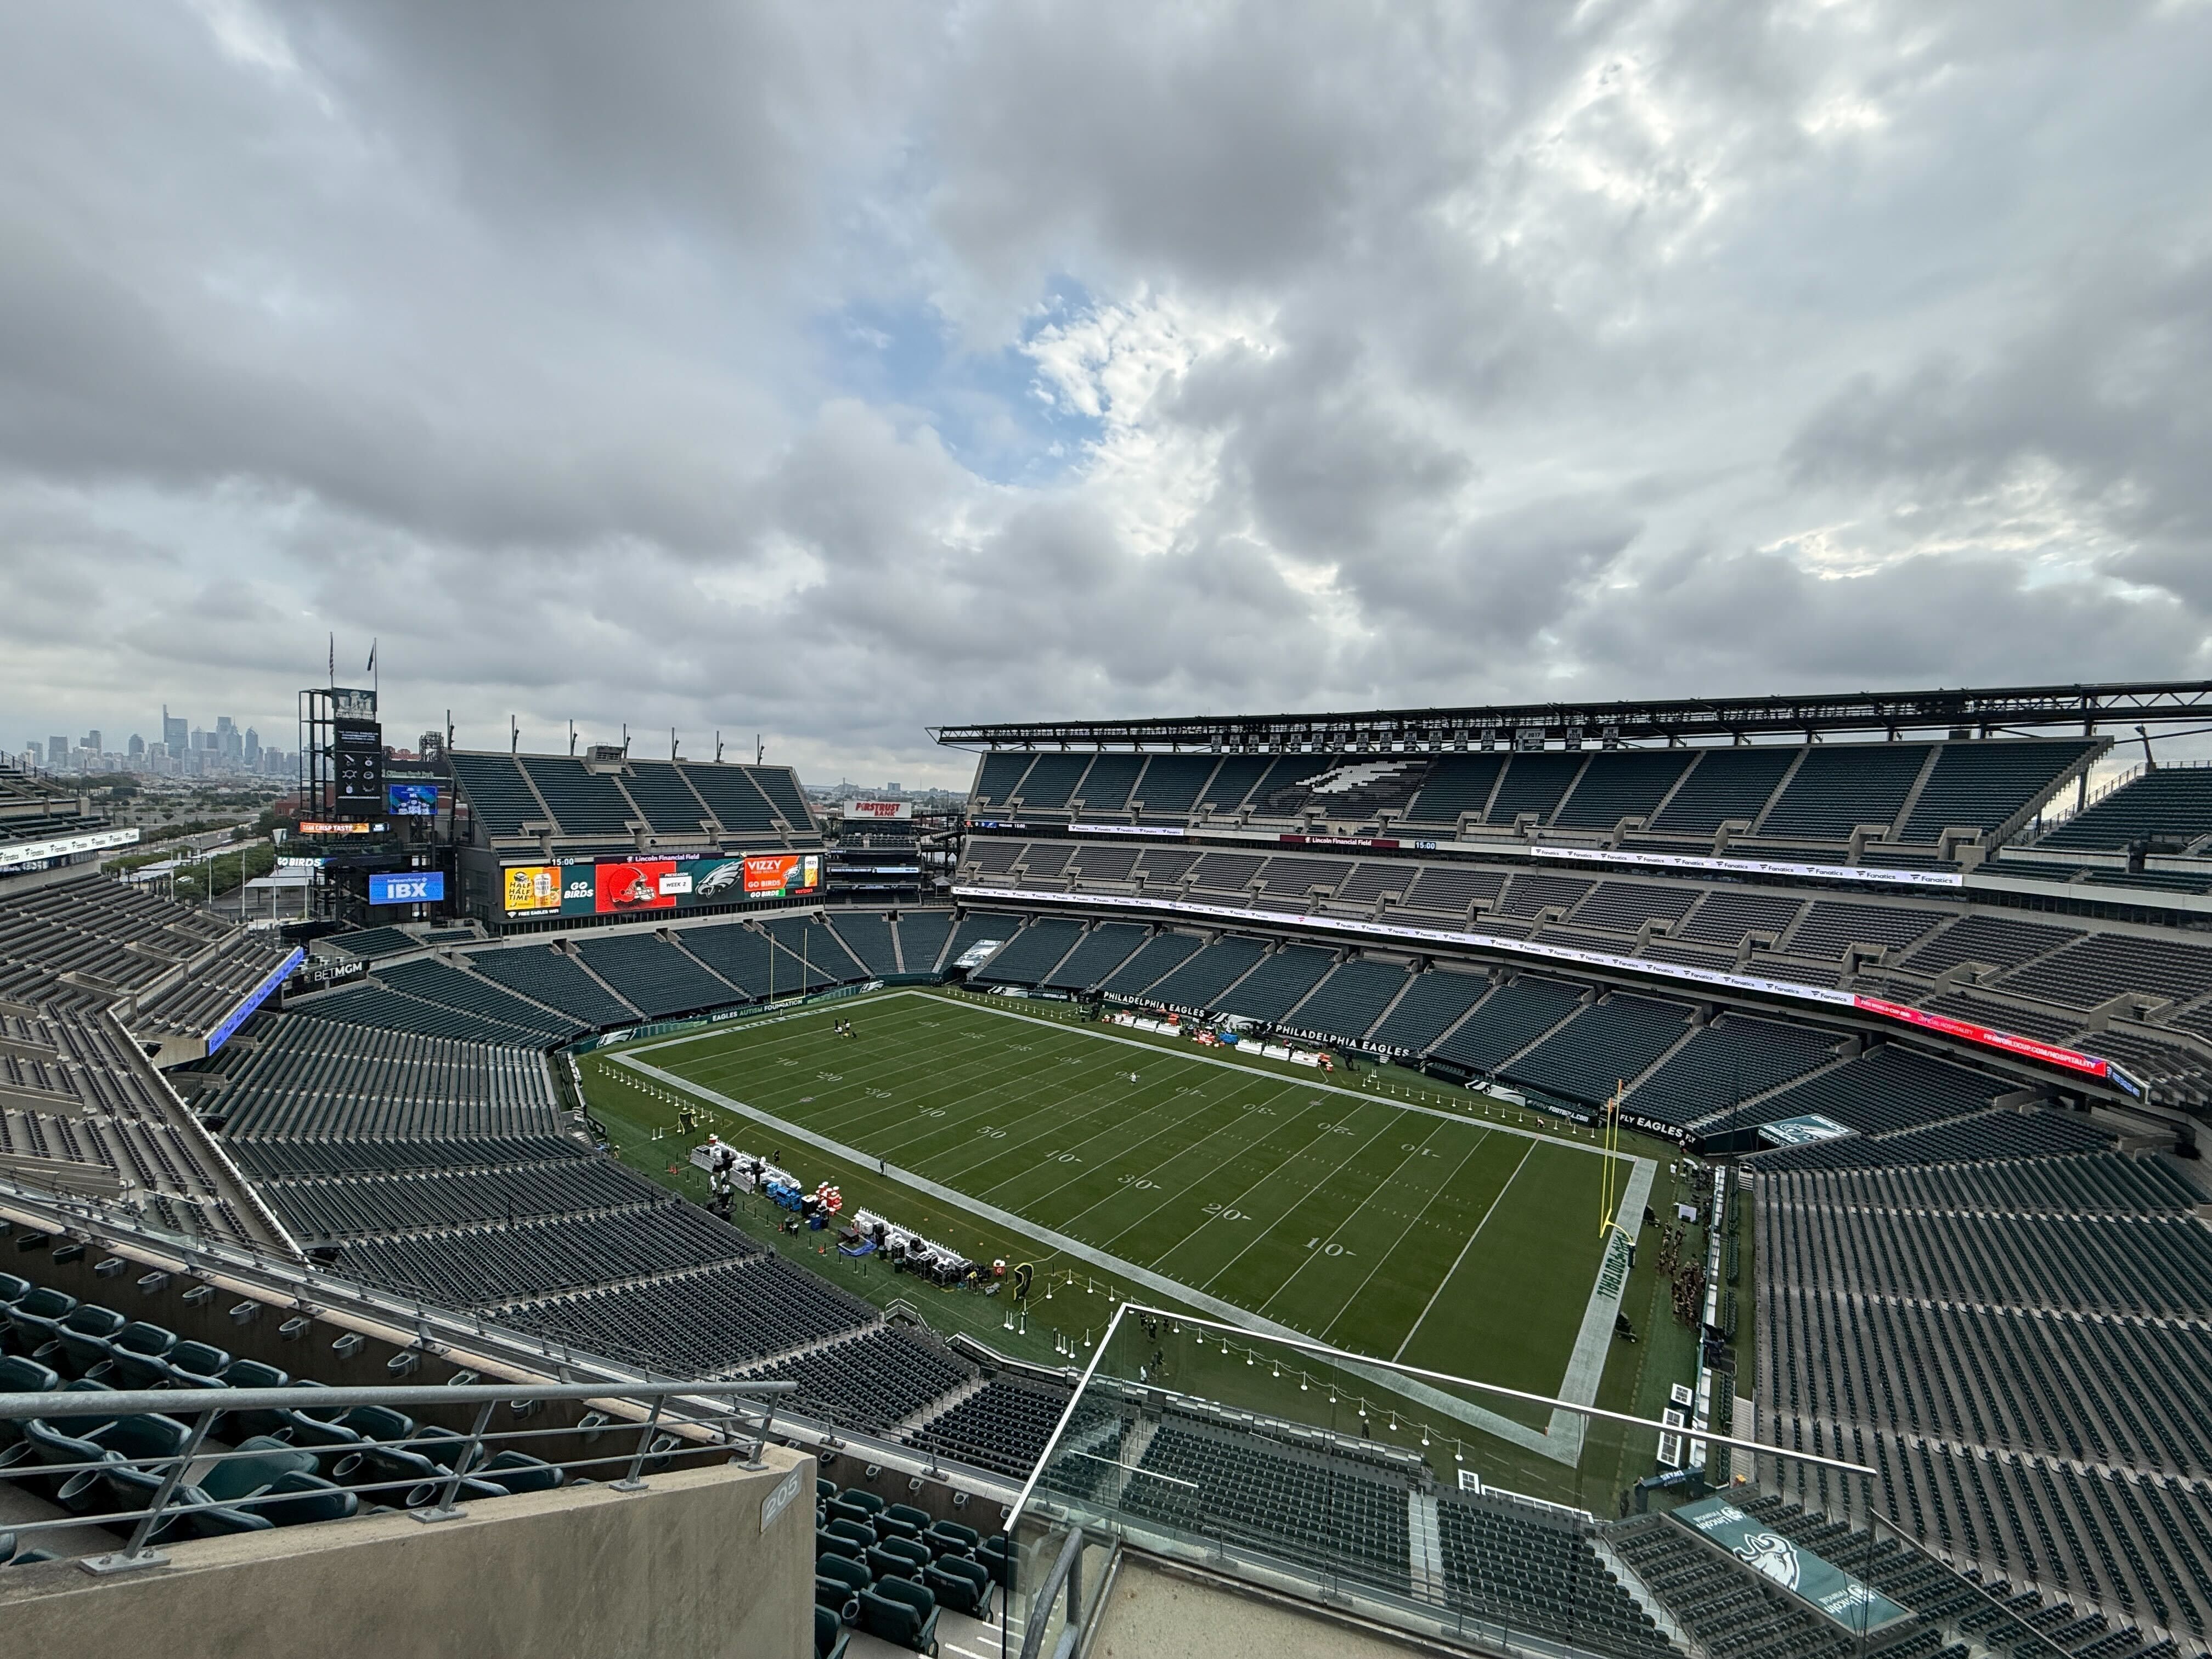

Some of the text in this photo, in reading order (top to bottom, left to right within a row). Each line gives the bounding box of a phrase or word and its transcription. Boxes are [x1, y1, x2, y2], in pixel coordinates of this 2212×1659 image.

[855, 803, 901, 811] FIRSTRUST
[278, 857, 322, 867] GO BIRDS
[747, 860, 783, 870] VIZZY
[387, 883, 427, 899] IBX
[571, 882, 588, 890] GO
[564, 889, 594, 899] BIRDS
[314, 962, 362, 981] BETMGM
[1691, 972, 1713, 980] Fanatics
[1731, 979, 1755, 987] Fanatics
[1775, 985, 1799, 994] Fanatics
[1104, 991, 1205, 1018] PHILADELPHIA EAGLES
[1820, 993, 1847, 1002] Fanatics
[713, 999, 803, 1022] EAGLES AUTISM FOUNDATION
[1872, 1003, 1889, 1012] WORLD
[1917, 1017, 1974, 1035] OFFICIAL HOSPITALITY
[1276, 1024, 1410, 1057] PHILADELPHIA EAGLES
[816, 1073, 843, 1081] 20
[865, 1088, 892, 1098] 30
[1243, 1104, 1272, 1114] 30
[1317, 1122, 1350, 1133] 20
[1620, 1114, 1696, 1143] FLY EAGLES FLY
[1811, 1115, 1849, 1132] GEICO
[976, 1126, 1007, 1139] 50
[1758, 1130, 1780, 1144] GEICO
[1764, 1125, 1799, 1143] GEICO
[1401, 1143, 1433, 1156] 10
[1118, 1174, 1153, 1189] 30
[1201, 1203, 1242, 1220] 20
[1302, 1237, 1344, 1256] 10
[1597, 1253, 1627, 1300] FOOTBALL
[765, 1474, 798, 1520] 205
[1692, 1511, 1722, 1522] Financial
[1696, 1516, 1731, 1530] Lincoln
[1818, 1589, 1848, 1606] Financial
[1824, 1596, 1863, 1615] Lincoln
